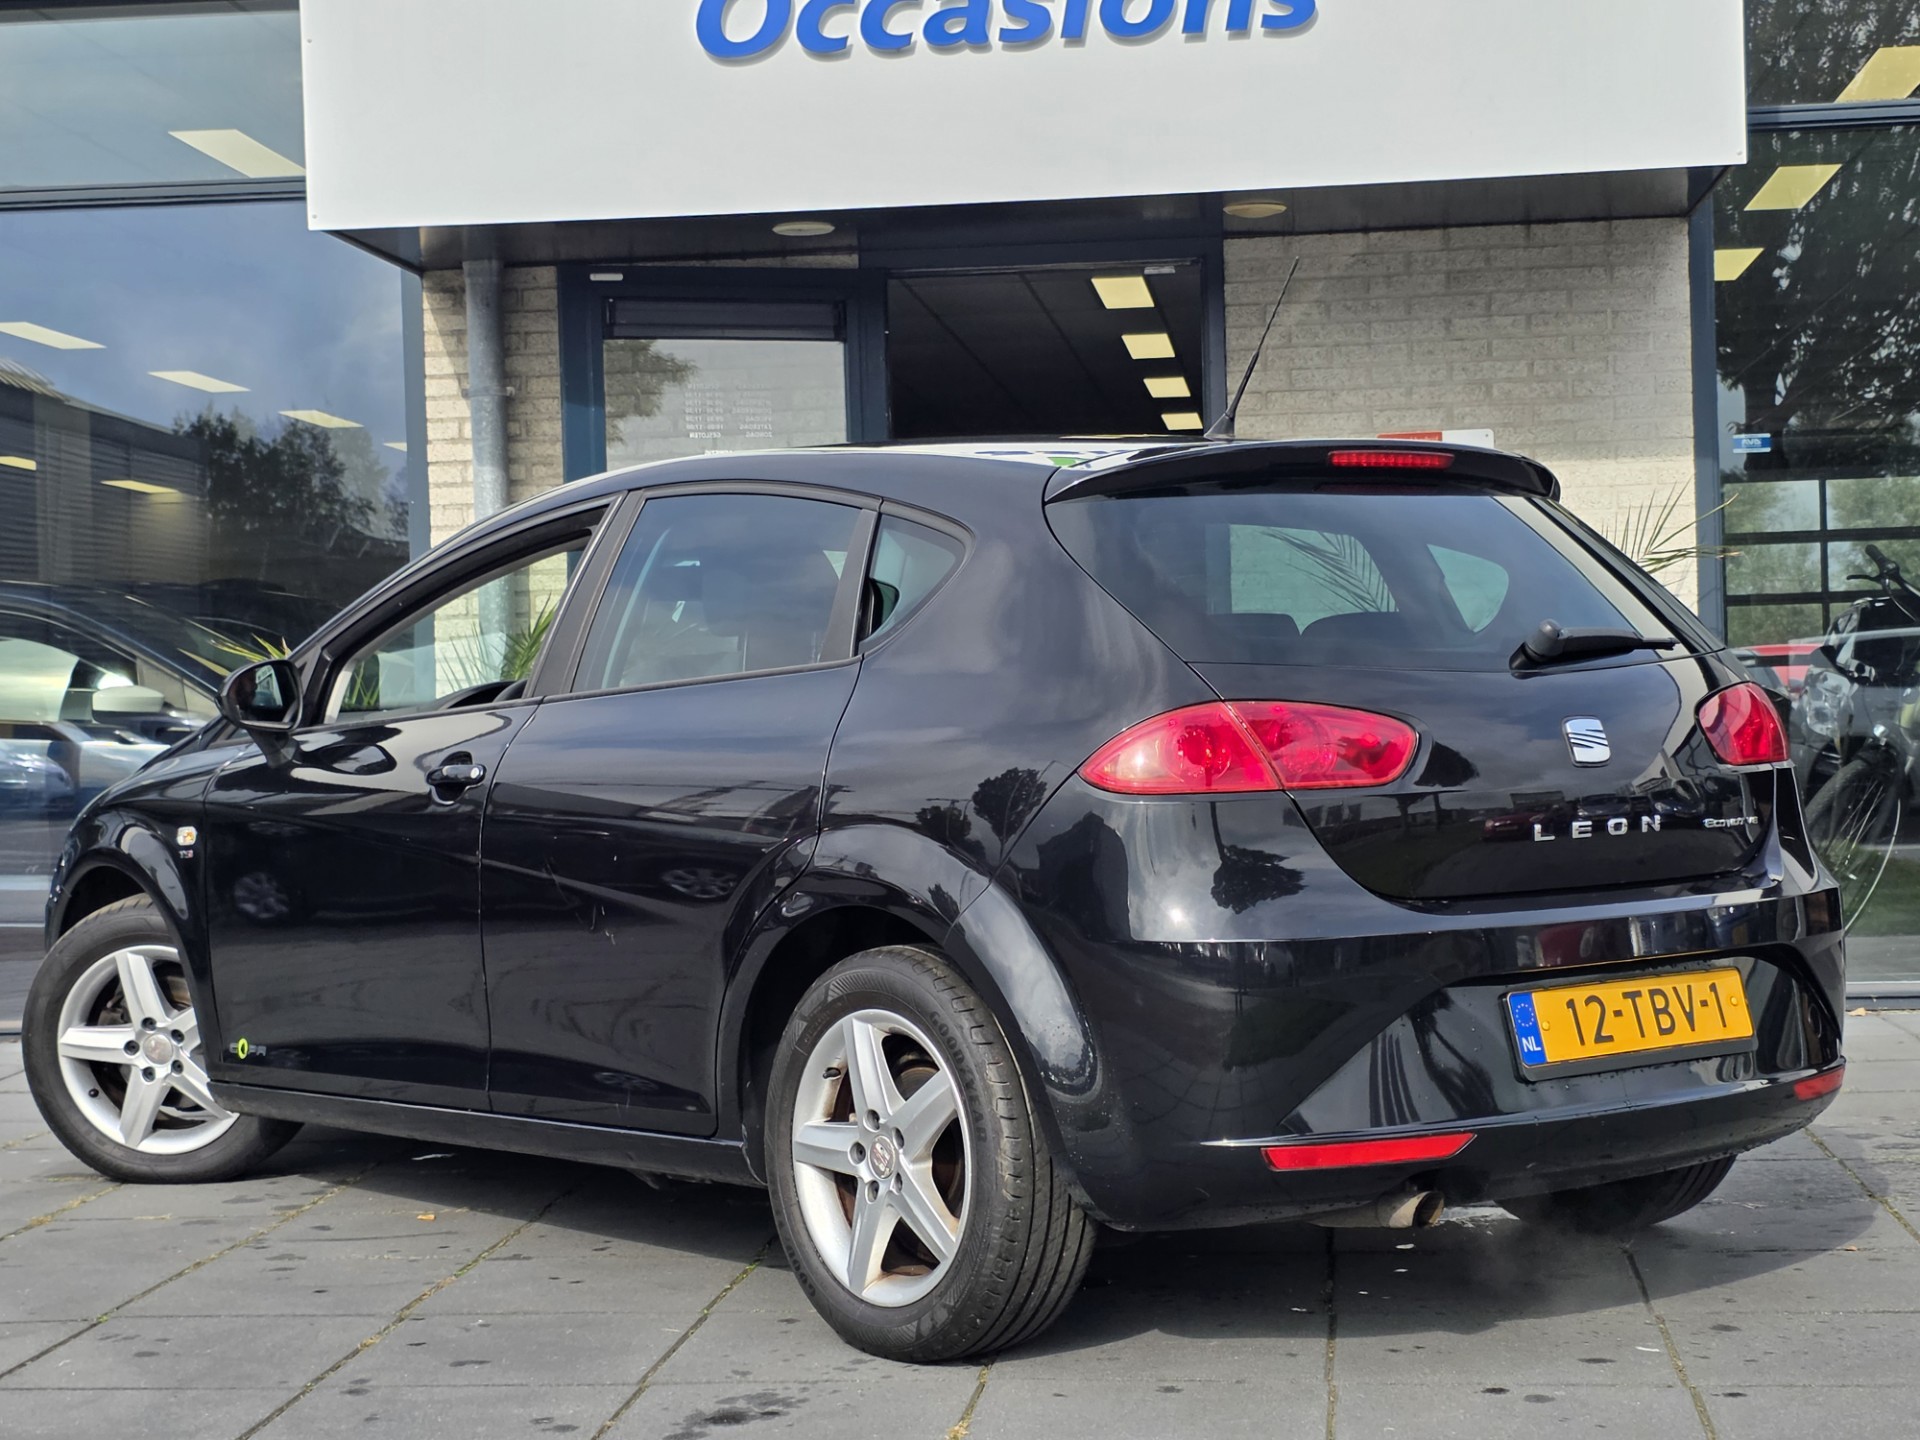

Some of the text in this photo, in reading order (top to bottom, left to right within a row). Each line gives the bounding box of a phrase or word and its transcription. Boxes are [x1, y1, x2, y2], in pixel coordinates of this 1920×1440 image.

[1534, 815, 1661, 842] LEON
[1565, 982, 1727, 1046] 12-TBV-1
[1521, 1035, 1541, 1053] NL
